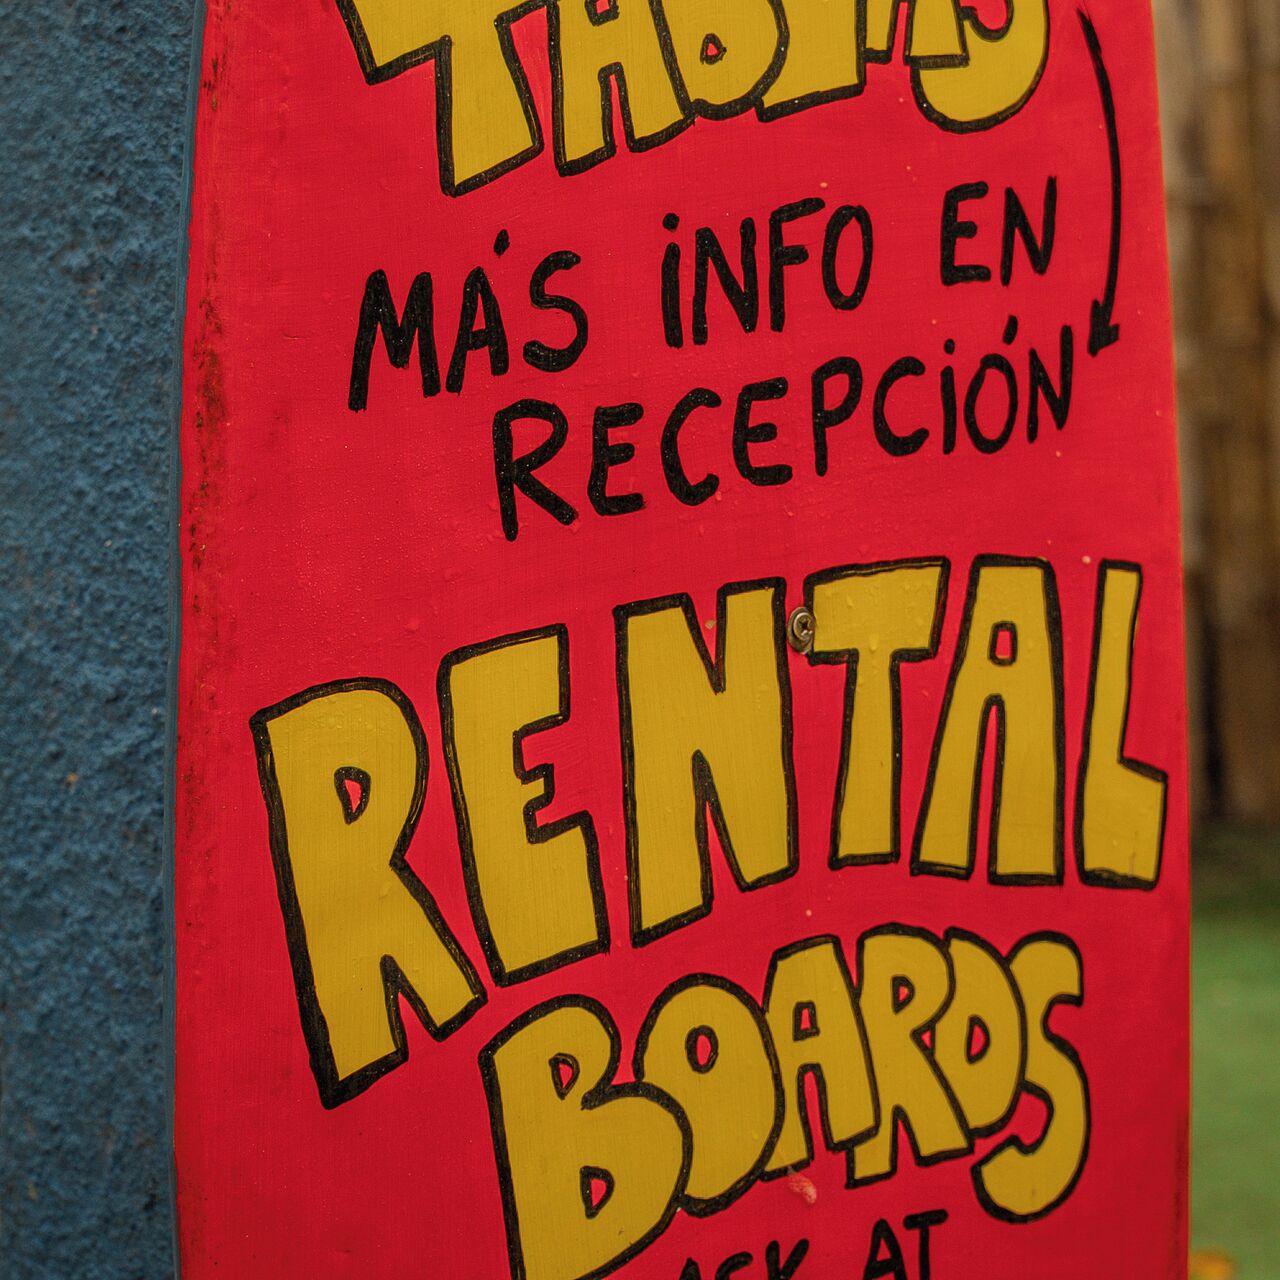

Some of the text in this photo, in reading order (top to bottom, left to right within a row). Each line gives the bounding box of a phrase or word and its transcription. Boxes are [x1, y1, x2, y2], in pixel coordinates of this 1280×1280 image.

[348, 230, 589, 412] MÁS
[941, 176, 1058, 286] EN
[250, 555, 1169, 1109] RENTAL
[479, 924, 1091, 1280] BOARDS
[862, 1209, 949, 1280] AT
